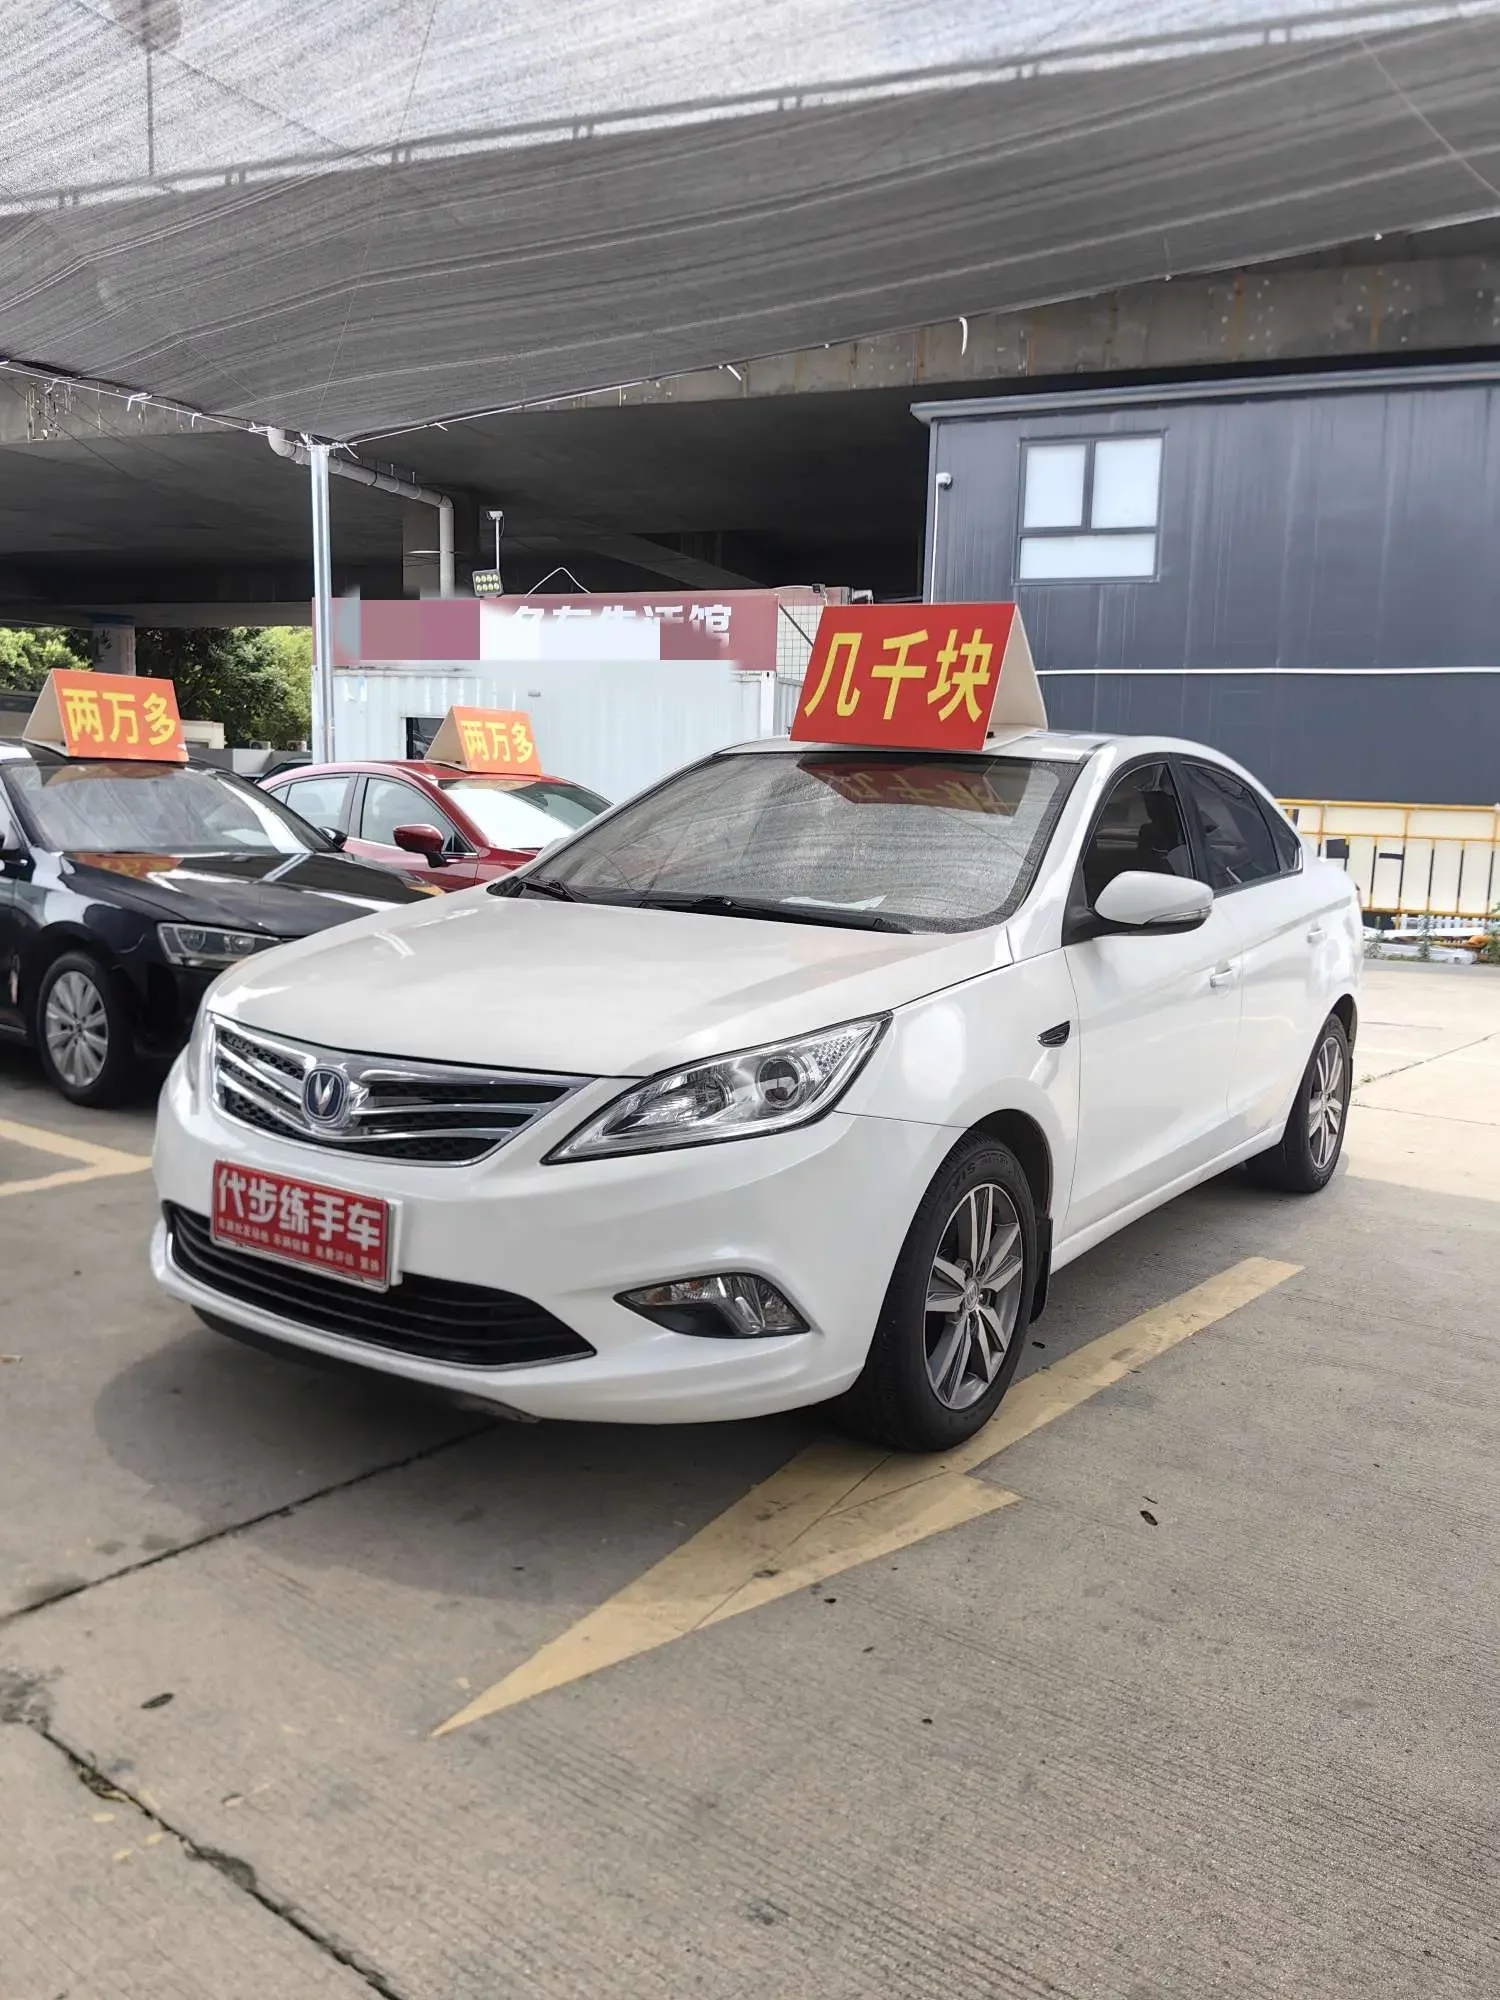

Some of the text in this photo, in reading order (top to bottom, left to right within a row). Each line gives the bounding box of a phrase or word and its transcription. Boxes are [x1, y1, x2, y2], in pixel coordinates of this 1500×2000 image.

[804, 628, 993, 722] 几千块
[62, 688, 176, 745] 两万多
[461, 720, 533, 763] 两万多
[218, 1168, 381, 1251] 代步练手车
